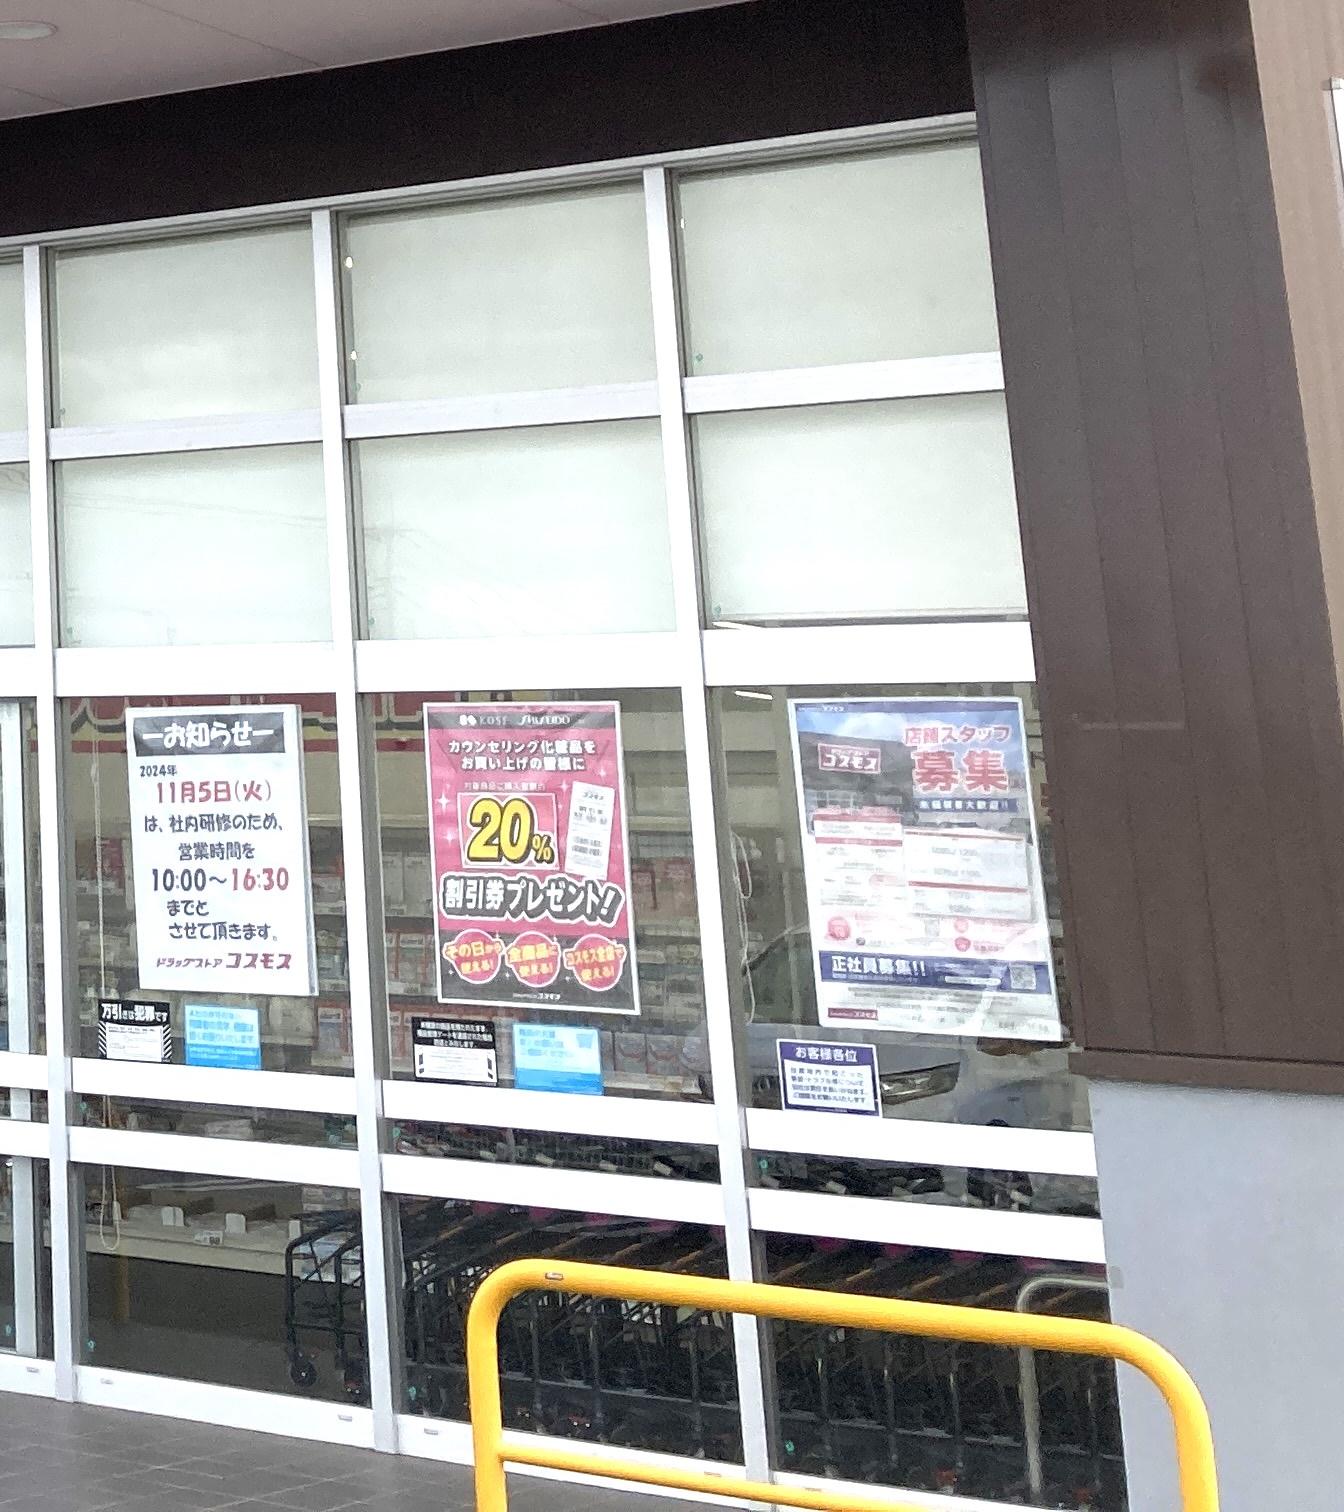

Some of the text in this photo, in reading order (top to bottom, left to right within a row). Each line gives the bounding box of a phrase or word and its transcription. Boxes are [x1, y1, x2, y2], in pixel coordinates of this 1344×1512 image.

[448, 739, 597, 755] カウンセリング化粧品を
[139, 763, 178, 778] 2024年
[461, 756, 585, 772] お買い上げの皆様に
[822, 753, 880, 771] コスモス
[913, 748, 1008, 792] 募集
[156, 778, 272, 804] 11月5日(火)
[143, 813, 284, 833] は、社内研修のため、
[467, 796, 556, 865] 20%
[178, 842, 256, 862] 営業時間を
[444, 876, 615, 918] 割引券プレゼント!
[166, 899, 211, 917] までと
[167, 922, 279, 943] させて頂きます。
[156, 952, 293, 971] ドラッグストア コスモス
[795, 1045, 858, 1063] お客様各位
